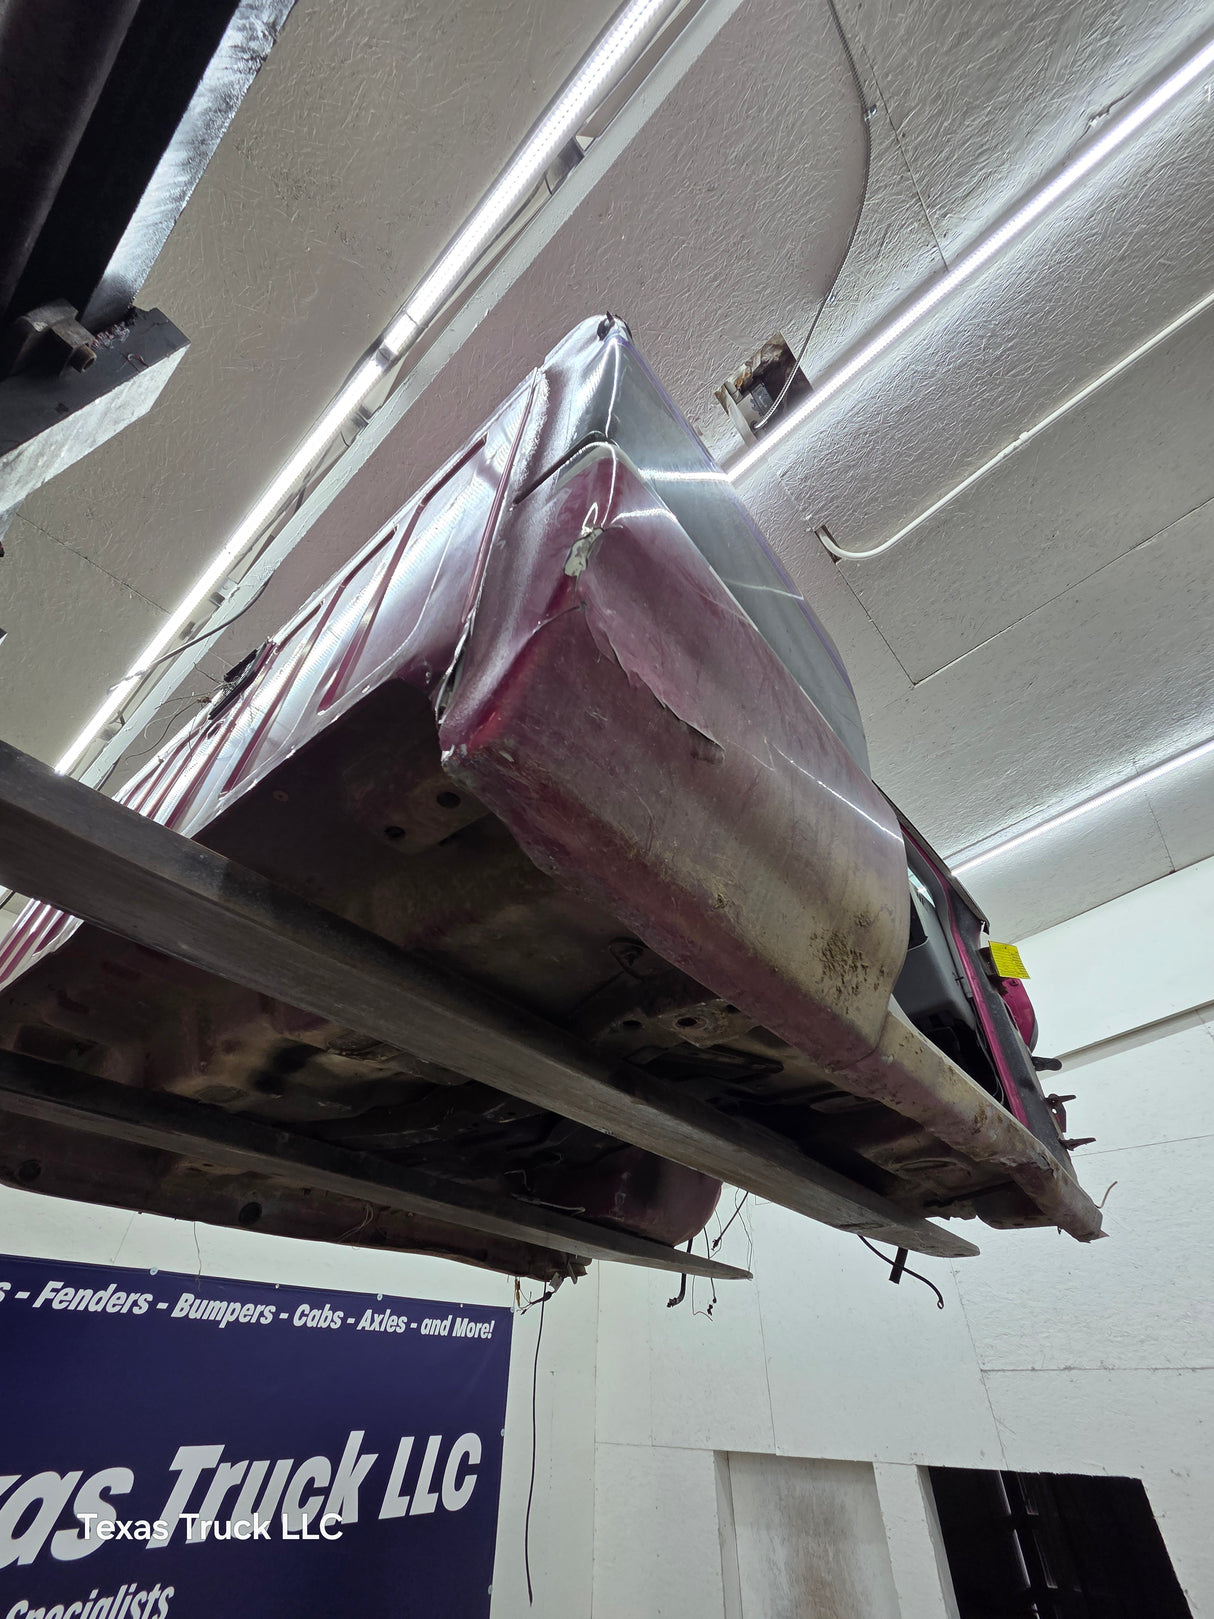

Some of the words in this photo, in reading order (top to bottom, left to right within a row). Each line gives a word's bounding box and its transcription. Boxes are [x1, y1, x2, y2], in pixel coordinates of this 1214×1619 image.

[32, 1280, 154, 1315] Fenders
[170, 1292, 277, 1329] Bumpers
[292, 1303, 345, 1330] Cabs
[356, 1308, 408, 1334] Axles
[420, 1314, 453, 1337] and
[452, 1317, 496, 1340] More!
[145, 1430, 379, 1550] Truck
[378, 1432, 482, 1520] LLC
